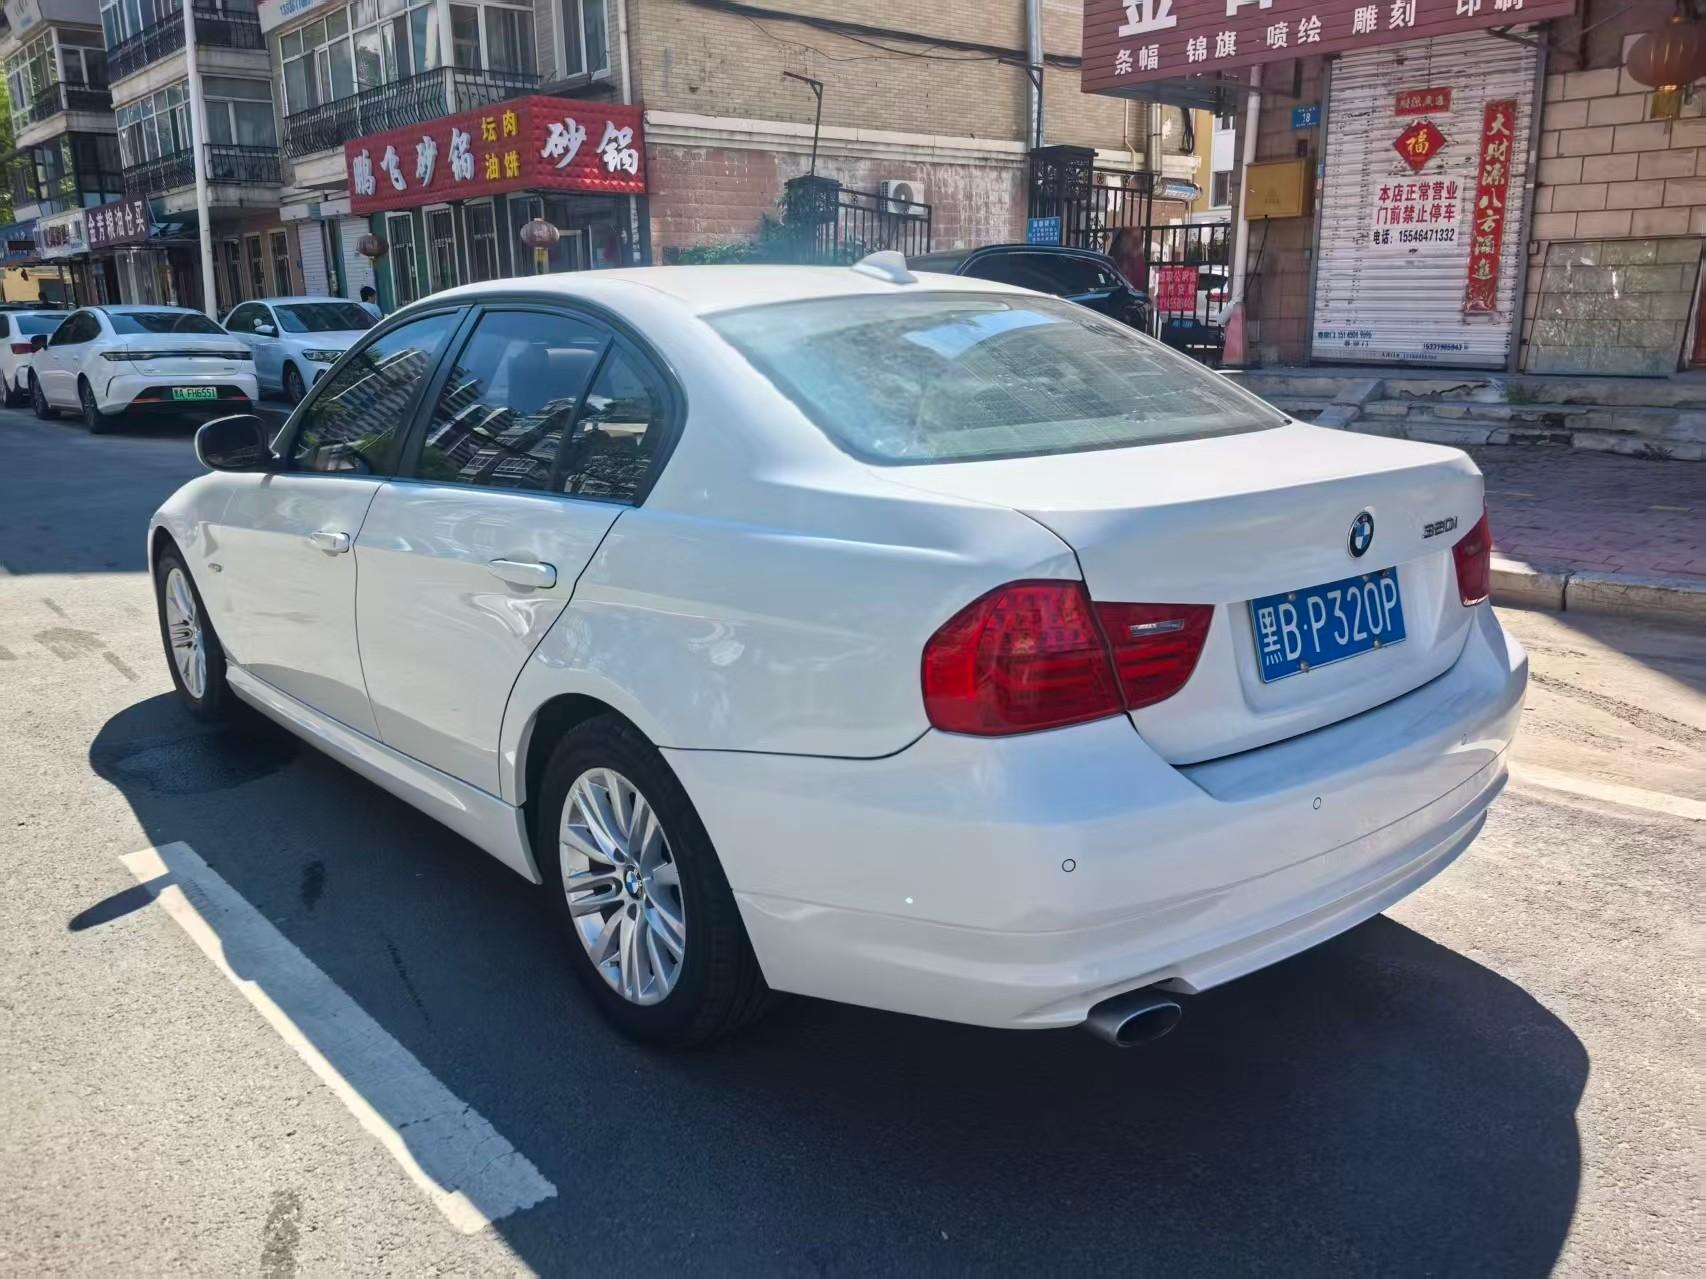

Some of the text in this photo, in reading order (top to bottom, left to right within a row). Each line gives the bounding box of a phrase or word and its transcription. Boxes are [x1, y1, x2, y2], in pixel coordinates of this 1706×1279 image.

[1114, 44, 1160, 76] 条幅
[1186, 31, 1237, 64] 锦旗
[1266, 14, 1322, 50] 喷绘
[1352, 0, 1417, 36] 雕刻
[481, 109, 519, 142] 坛肉
[540, 117, 639, 176] 砂锅
[1405, 129, 1429, 155] 福
[485, 150, 520, 180] 油饼
[1378, 181, 1459, 204] 本店正常营业
[1376, 203, 1456, 225] 门前禁止停车
[1398, 228, 1455, 243] 15546471332
[1422, 515, 1459, 540] 320i
